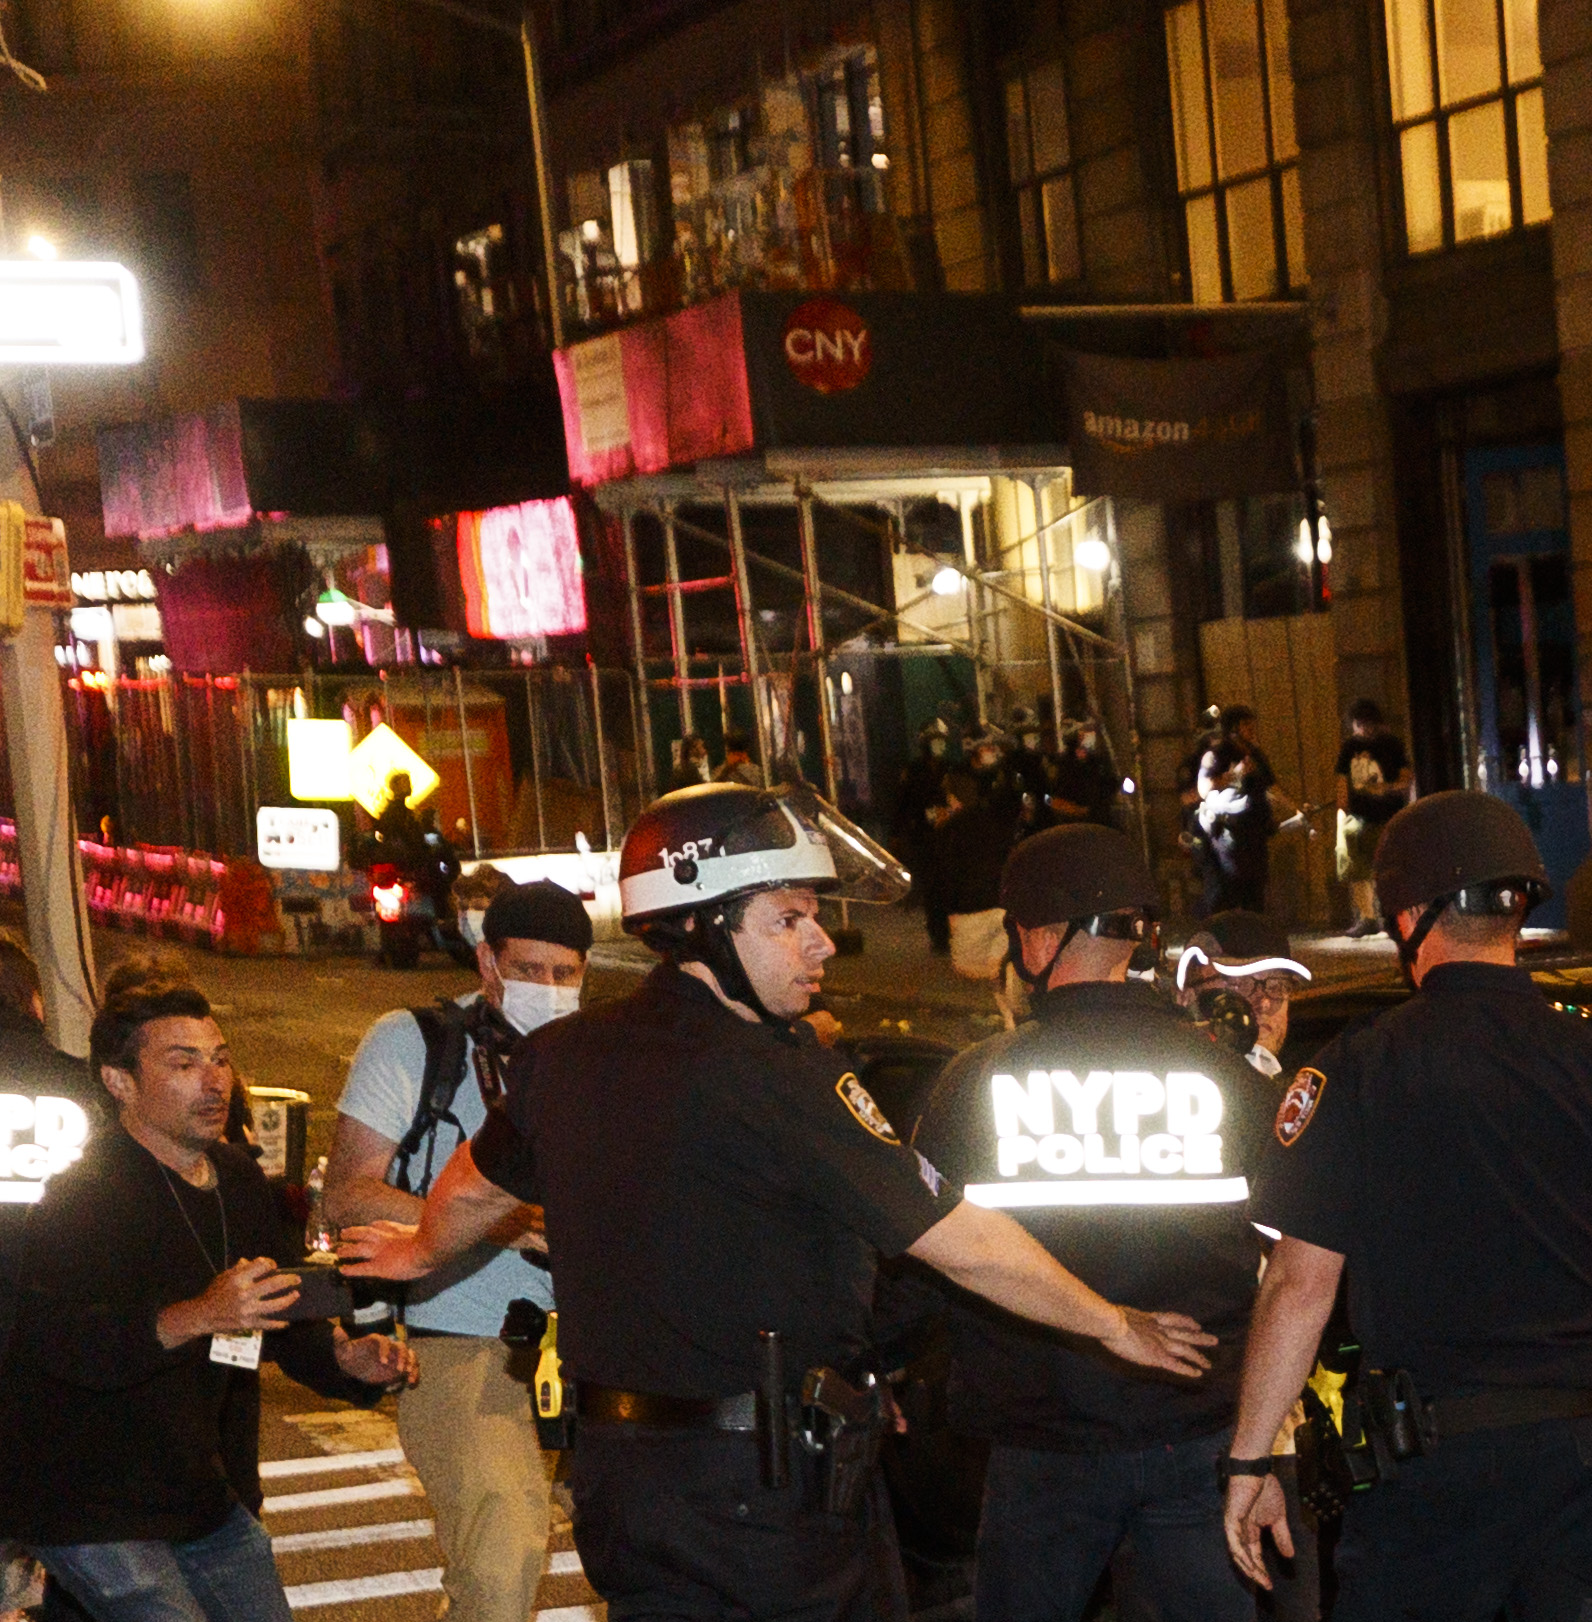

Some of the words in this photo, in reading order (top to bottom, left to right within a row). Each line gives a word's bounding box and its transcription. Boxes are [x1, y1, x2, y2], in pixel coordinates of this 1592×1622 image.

[785, 328, 867, 366] CNY
[1083, 410, 1190, 442] amazon
[991, 1070, 1223, 1136] NYPD
[997, 1134, 1223, 1177] POLICE
